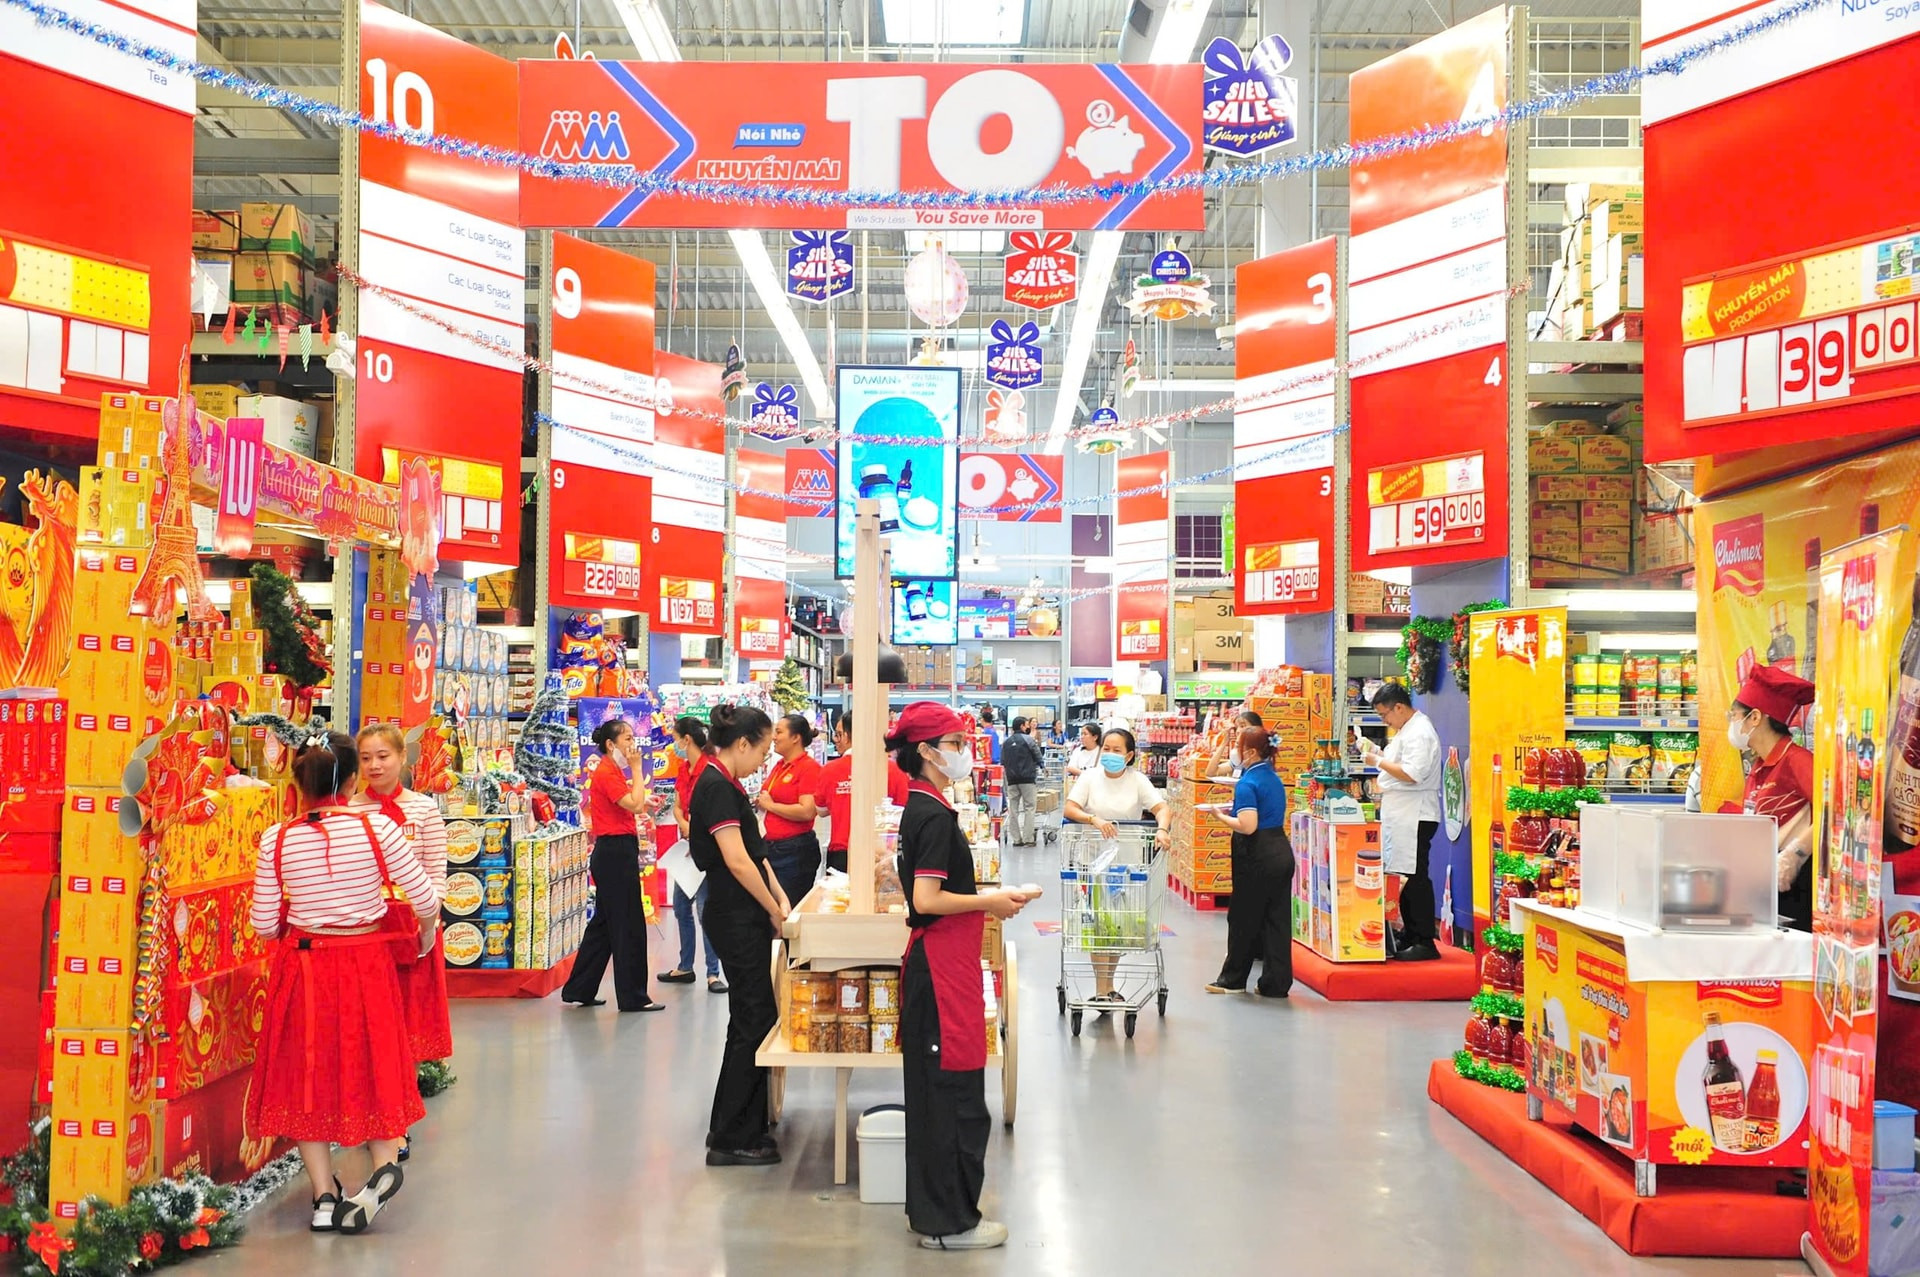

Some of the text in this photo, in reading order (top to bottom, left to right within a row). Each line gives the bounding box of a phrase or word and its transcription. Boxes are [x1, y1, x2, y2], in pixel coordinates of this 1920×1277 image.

[147, 67, 168, 87] Tea
[365, 57, 434, 146] 10
[1457, 60, 1501, 137] 4
[1203, 98, 1290, 124] SALES
[826, 69, 1066, 202] TO
[697, 155, 792, 180] KHUYẾN
[853, 211, 1036, 227] We Say Less You Save More
[488, 234, 512, 250] Snack
[789, 258, 853, 279] SALES
[1007, 268, 1076, 288] SALES
[487, 284, 511, 300] Snack
[555, 267, 582, 320] 9
[1306, 272, 1333, 325] 3
[1714, 281, 1768, 322] KHUYẾN
[1728, 284, 1792, 331] PROMOTION
[364, 349, 393, 384] 10
[987, 356, 1042, 372] SALES
[1484, 356, 1502, 387] 4
[853, 374, 896, 385] DAMIAN
[656, 377, 673, 417] 8
[226, 436, 257, 517] LU
[553, 467, 565, 489] 9
[1320, 475, 1331, 496] 3
[335, 491, 353, 515] 1846
[651, 527, 660, 543] 8
[1715, 535, 1763, 568] Cholimex
[736, 580, 742, 592] 7
[1215, 635, 1242, 648] 3M
[564, 677, 583, 691] Tide
[1575, 738, 1601, 748] Knorr
[1675, 1137, 1706, 1155] mới
